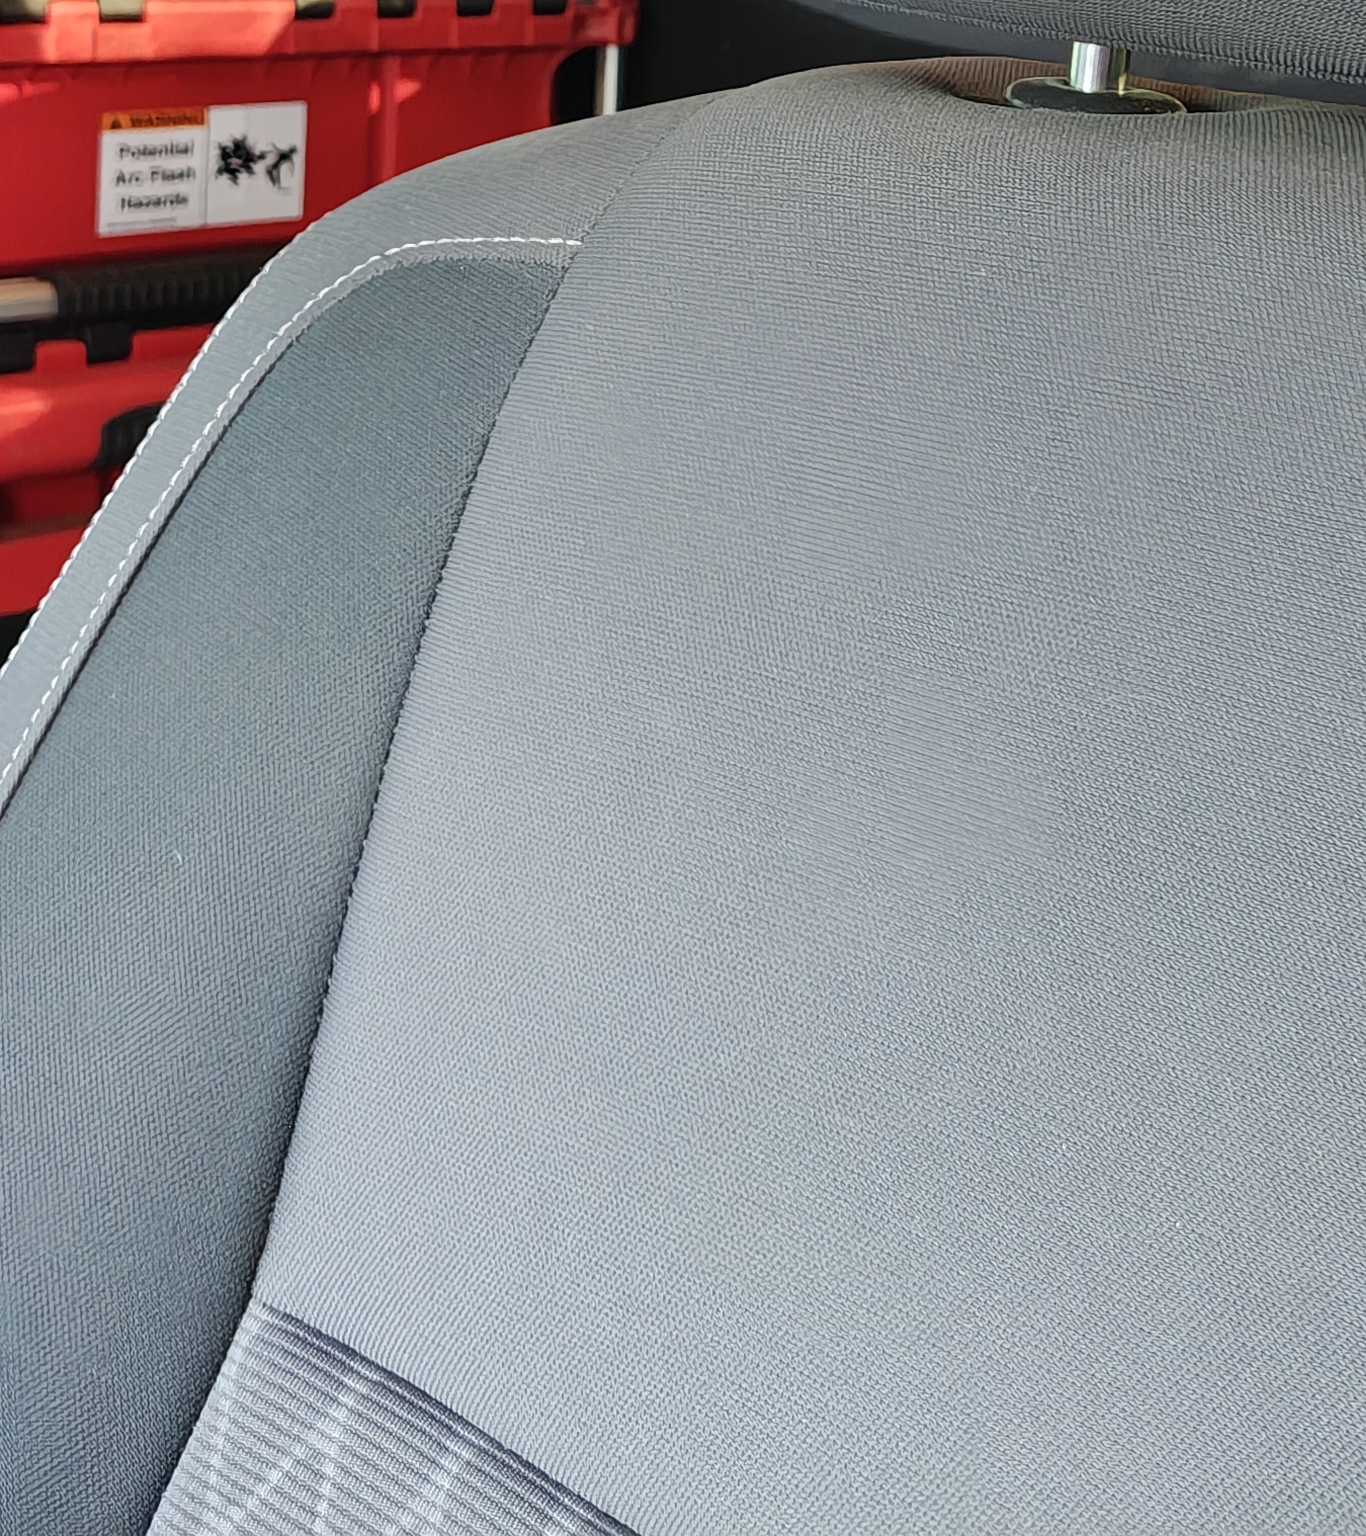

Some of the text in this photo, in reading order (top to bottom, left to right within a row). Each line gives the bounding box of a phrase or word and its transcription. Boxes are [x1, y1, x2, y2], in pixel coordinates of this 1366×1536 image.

[118, 139, 195, 160] Potential
[115, 166, 197, 186] Arc Flash
